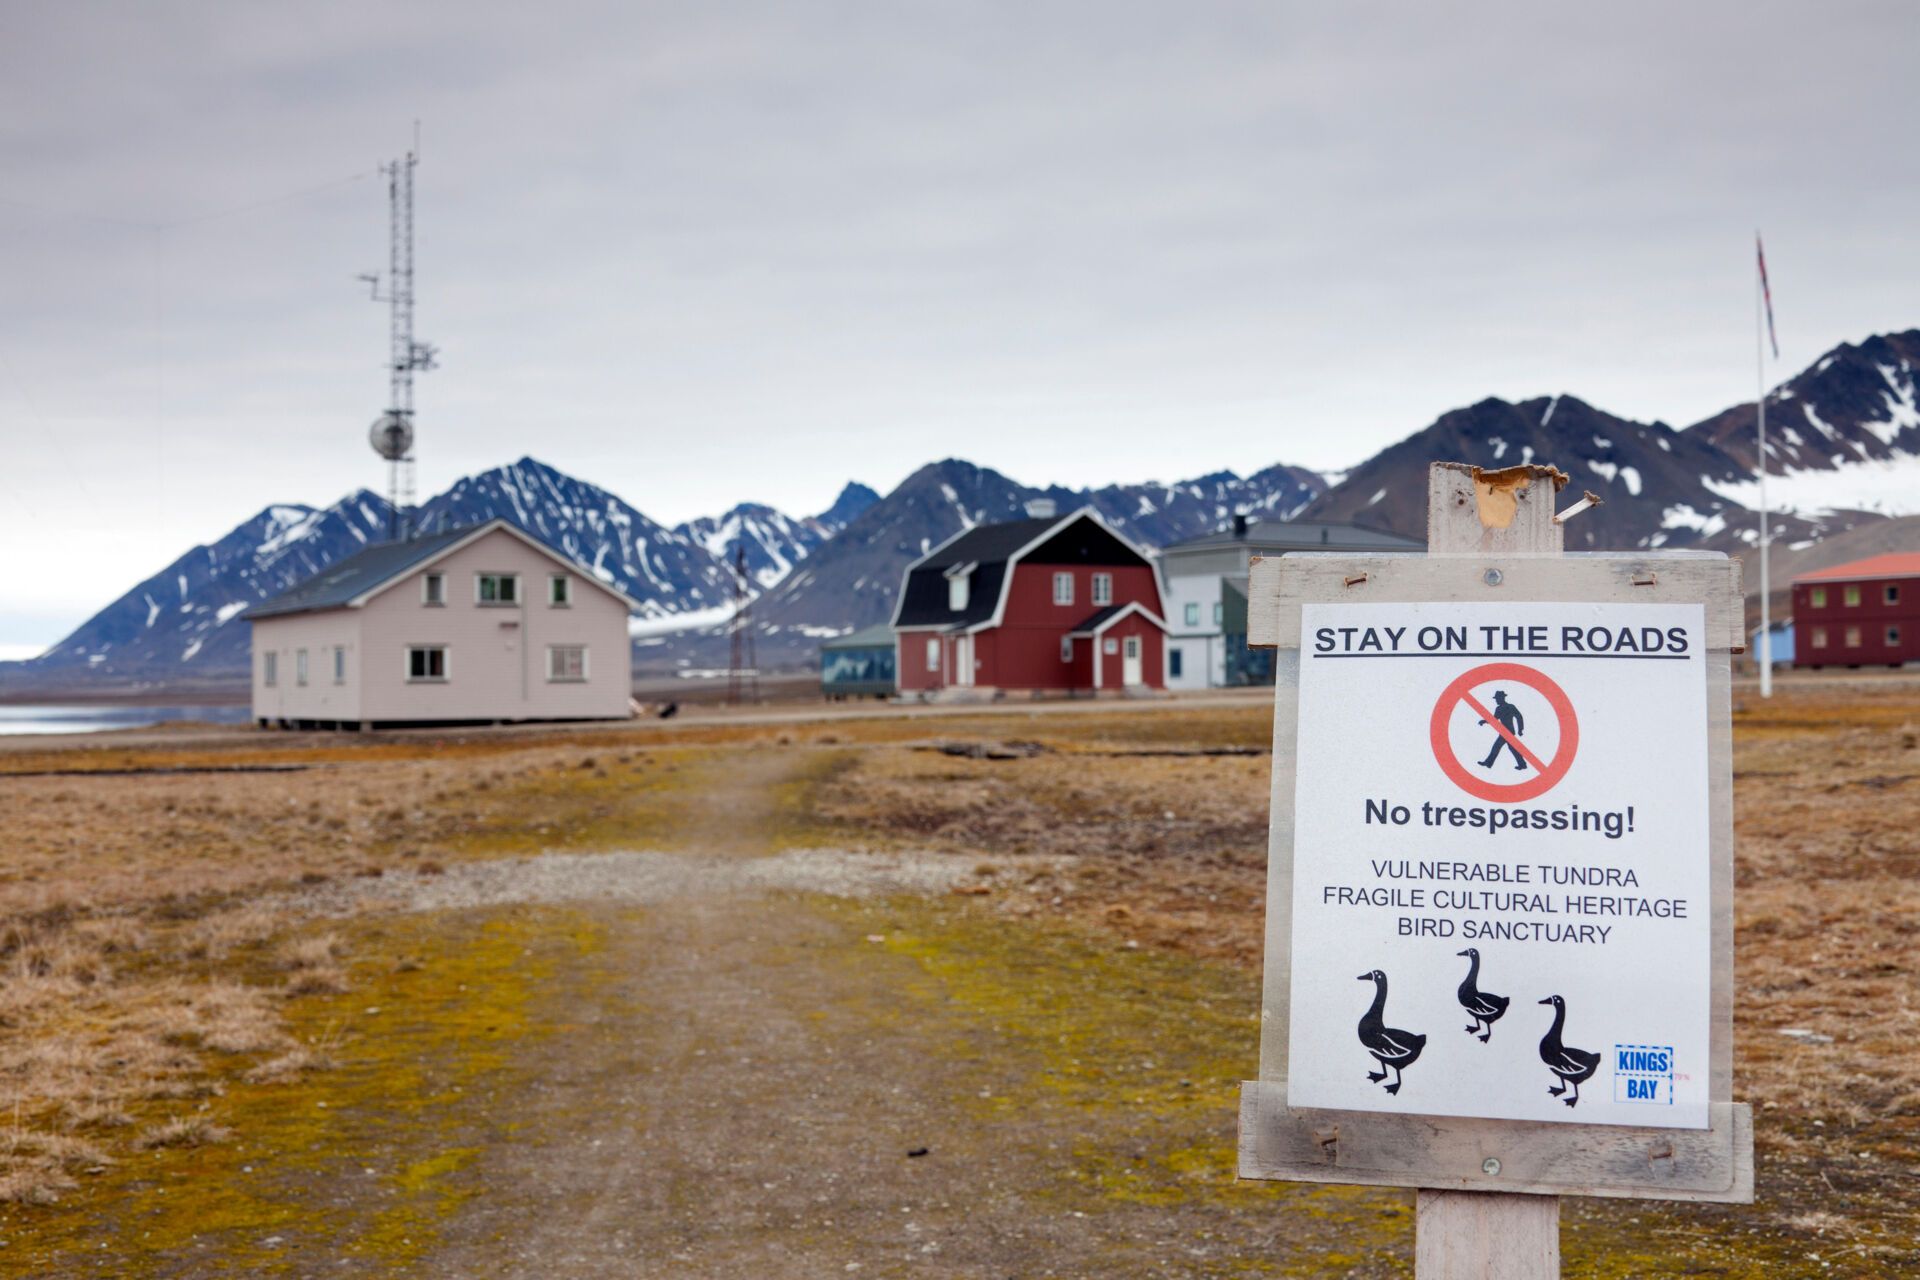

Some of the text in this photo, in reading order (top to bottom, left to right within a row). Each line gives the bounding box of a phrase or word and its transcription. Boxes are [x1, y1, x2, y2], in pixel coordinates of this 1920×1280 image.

[1315, 626, 1689, 653] STAY ON THE ROADS
[1365, 799, 1635, 839] No trespassing!
[1371, 859, 1639, 888] VULNERABLE TUNDRA
[1323, 886, 1687, 919] FRAGILE CULTURAL HERITAGE
[1398, 917, 1612, 944] BIRD SANCTUARY
[1618, 1051, 1668, 1072] KINGS
[1627, 1079, 1658, 1100] BAY
